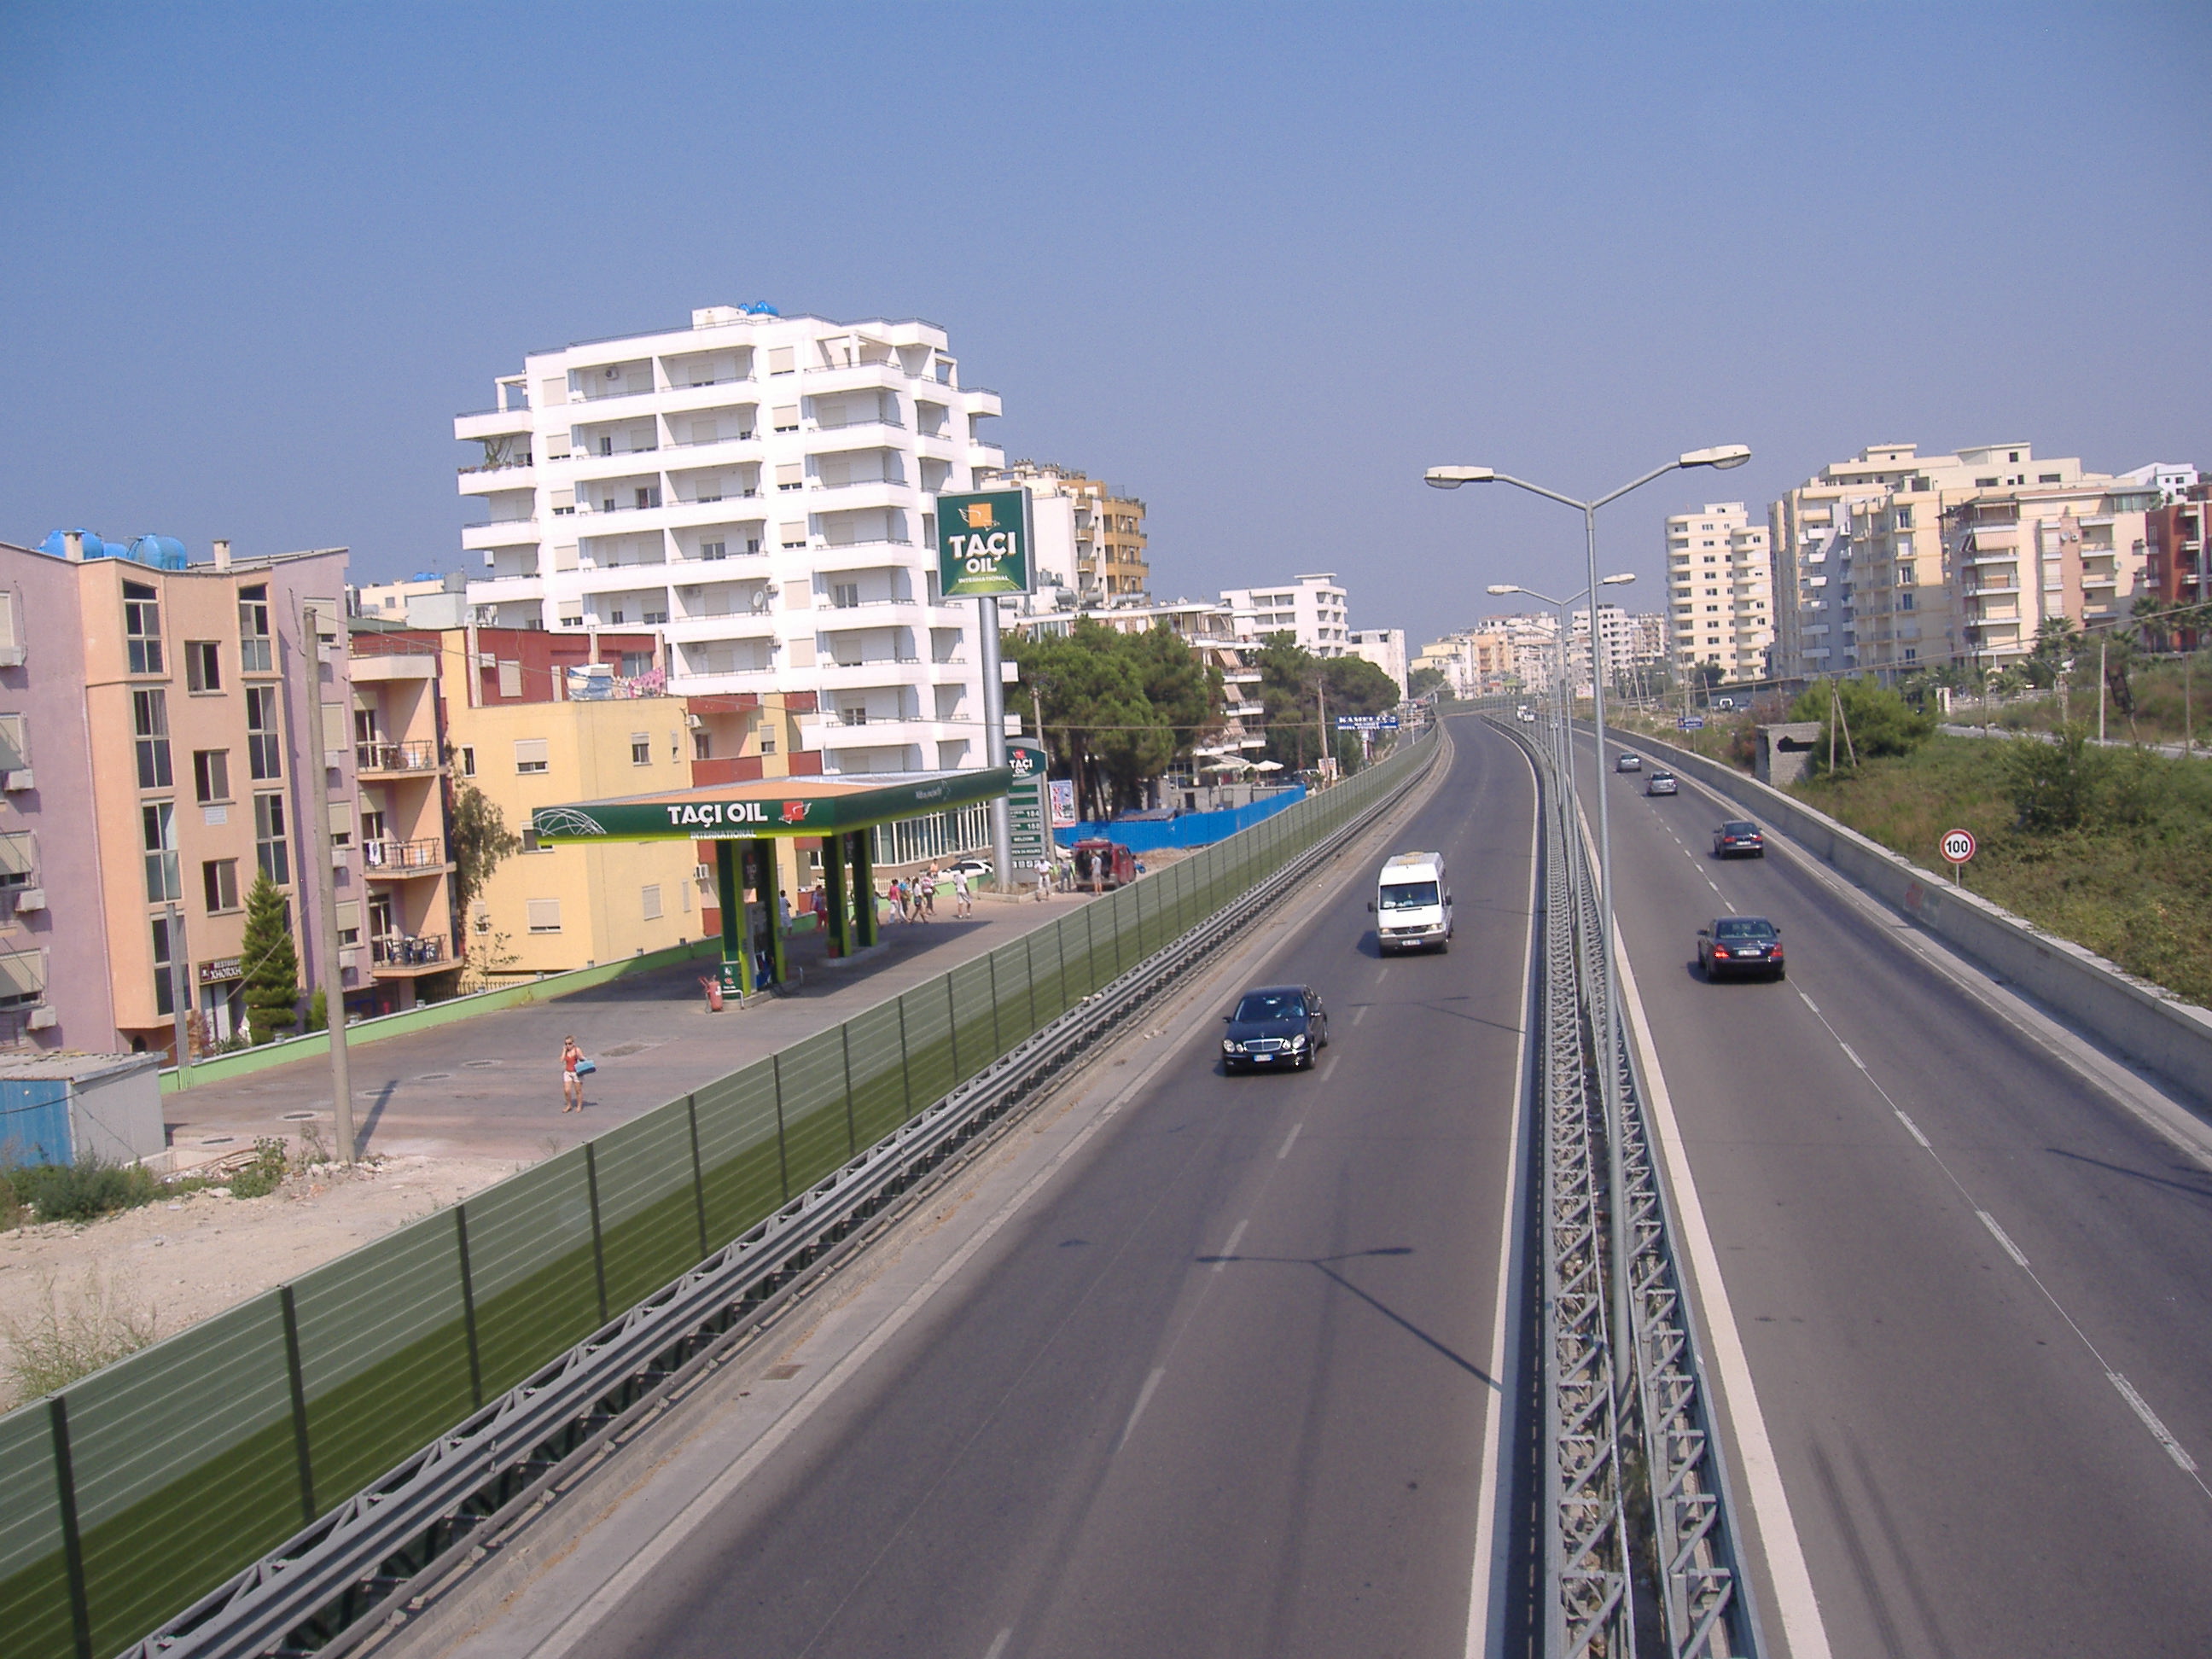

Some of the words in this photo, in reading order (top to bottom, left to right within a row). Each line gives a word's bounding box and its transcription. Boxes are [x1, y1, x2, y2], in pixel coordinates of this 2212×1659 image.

[948, 531, 1017, 562] TAÇI
[965, 557, 998, 574] OIL
[958, 574, 1010, 584] INTERNATIONAL
[1009, 759, 1033, 771] TAÇI
[667, 803, 723, 829] TAÇI
[726, 802, 768, 823] OIL
[690, 829, 757, 841] INTERNATIONAL
[1947, 840, 1968, 853] 100
